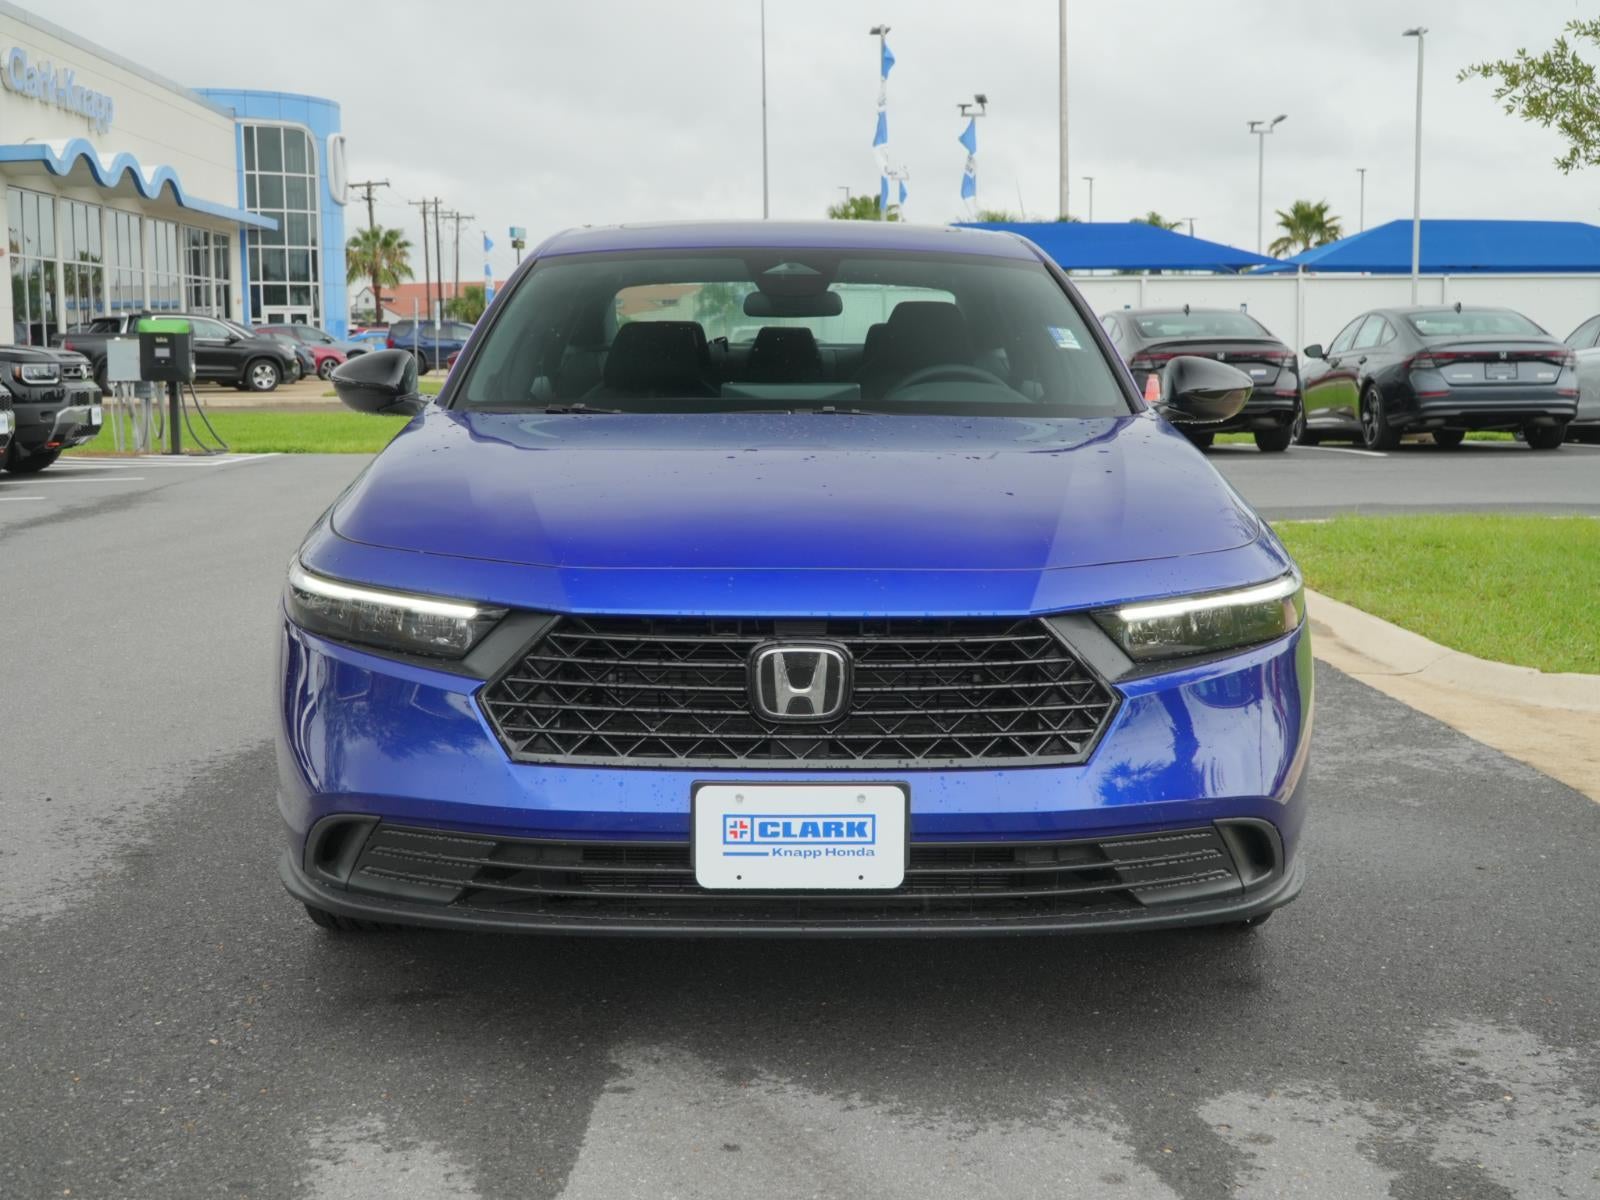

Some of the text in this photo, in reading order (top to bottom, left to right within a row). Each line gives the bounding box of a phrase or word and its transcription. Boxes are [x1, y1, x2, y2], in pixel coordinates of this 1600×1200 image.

[758, 821, 868, 838] CLARK
[772, 847, 875, 859] Knapp Honda
